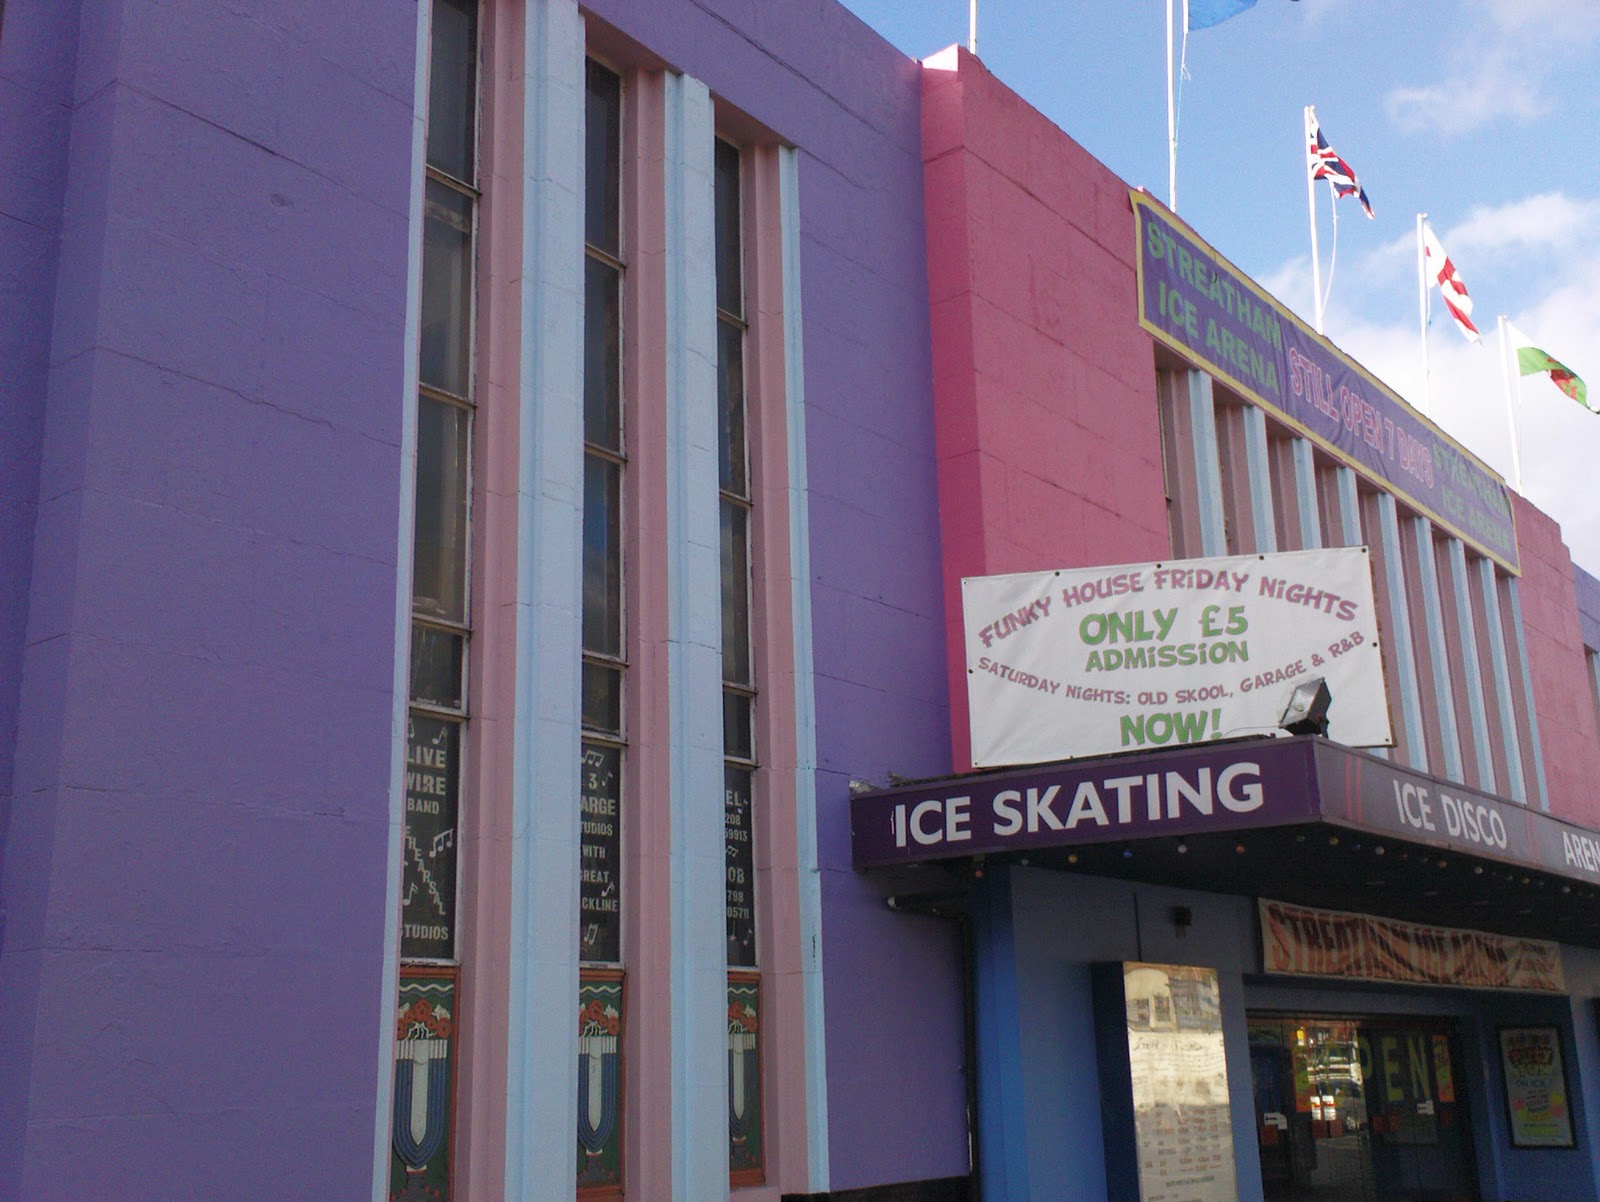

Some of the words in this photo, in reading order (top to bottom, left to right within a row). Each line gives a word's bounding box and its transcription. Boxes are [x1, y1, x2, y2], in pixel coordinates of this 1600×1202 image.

[1147, 221, 1283, 352] STREATHAM
[1158, 281, 1199, 338] ICE
[1206, 318, 1280, 397] ARENA
[1289, 347, 1339, 422] STILL
[1340, 386, 1384, 454] OPEN
[1383, 417, 1394, 460] 7
[978, 595, 1051, 649] FUNKY
[1063, 572, 1145, 608] HOUSE
[1079, 607, 1178, 646] ONLY
[1199, 604, 1249, 638] £5
[978, 657, 1061, 695] SATURDAY
[1138, 691, 1168, 706] OLD
[1176, 682, 1234, 706] SKOOL,
[1240, 659, 1307, 694] GARAGE
[1311, 652, 1325, 668] &
[1328, 631, 1365, 660] R&B
[1119, 708, 1223, 746] NOW!
[407, 744, 447, 769] LIVE
[407, 797, 440, 815] BAND
[581, 795, 616, 816] ARGE
[726, 790, 745, 806] EL
[895, 796, 972, 848] ICE
[992, 762, 1264, 836] SKATING
[1393, 780, 1436, 831] ICE
[1440, 793, 1508, 849] DISCO
[581, 821, 613, 836] TUDIOS
[405, 825, 446, 916] EHEARSAL
[581, 869, 610, 884] REAT
[728, 866, 745, 884] OB
[581, 896, 618, 913] CKLINE
[403, 923, 449, 941] TUDIOS
